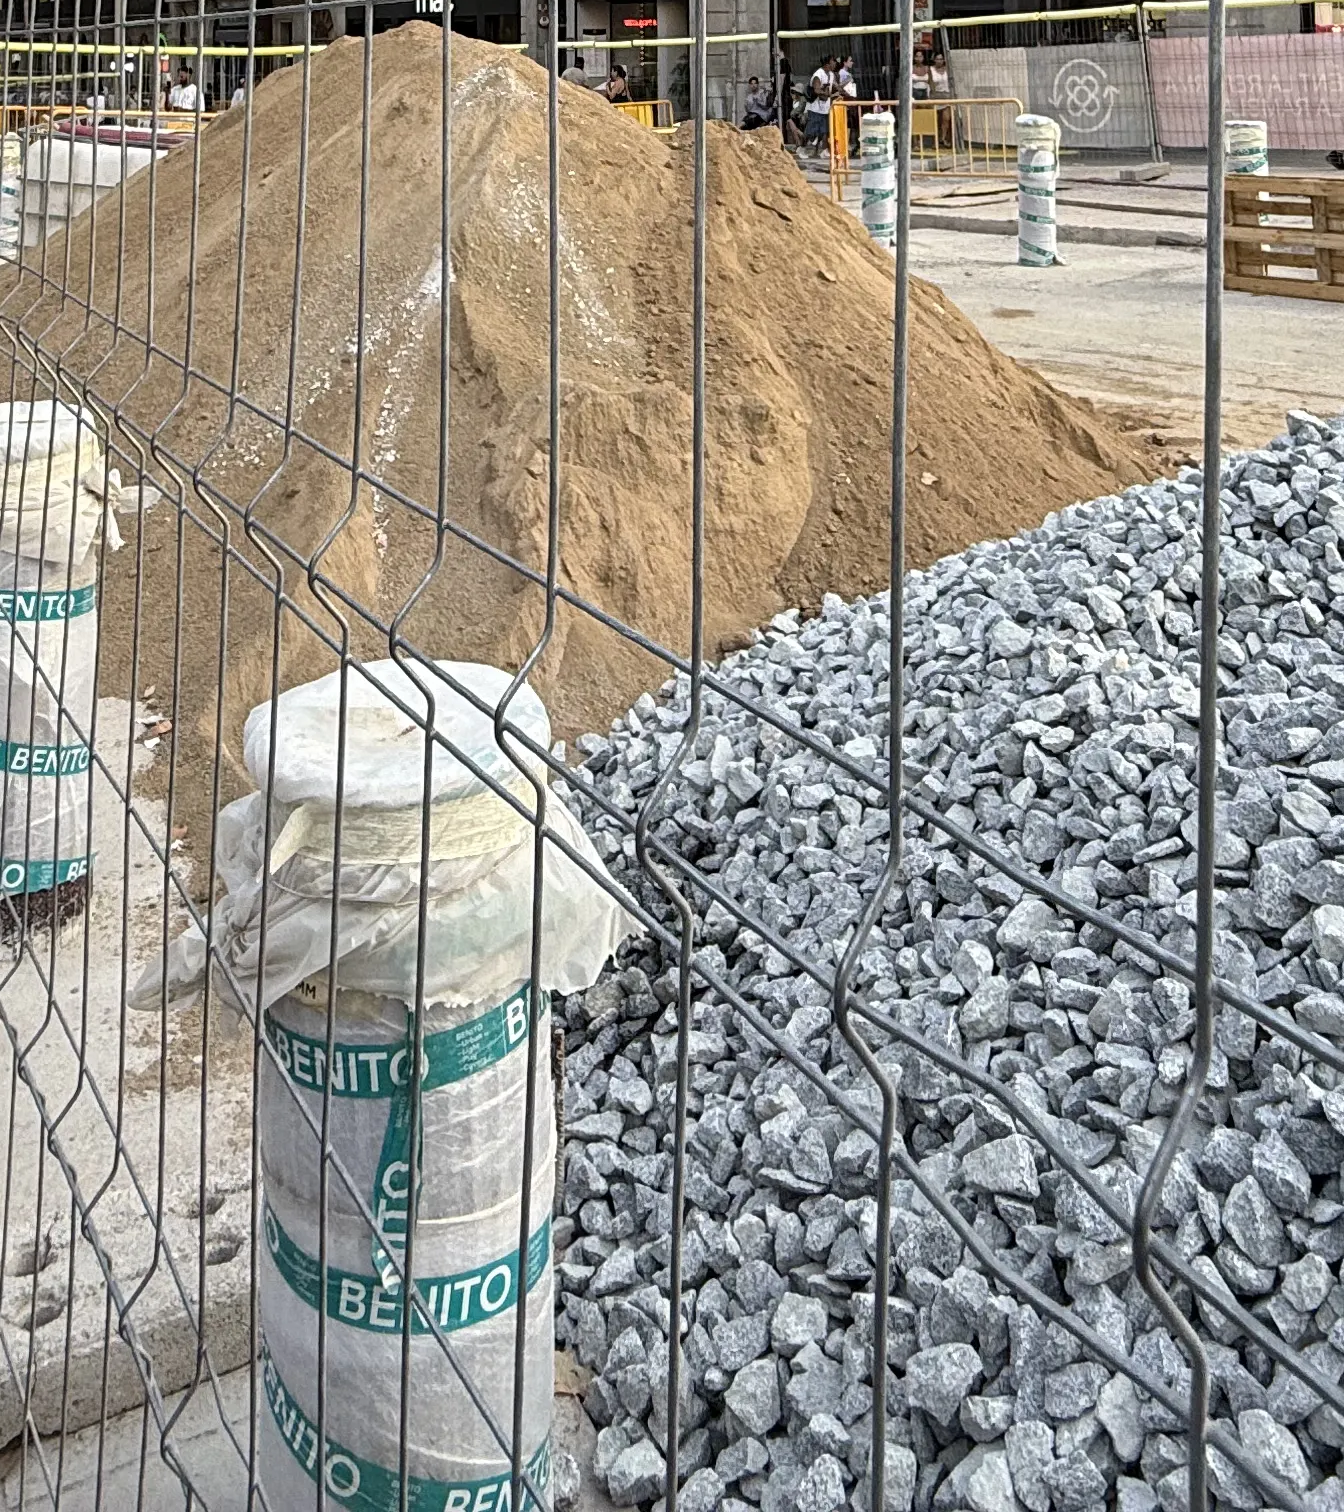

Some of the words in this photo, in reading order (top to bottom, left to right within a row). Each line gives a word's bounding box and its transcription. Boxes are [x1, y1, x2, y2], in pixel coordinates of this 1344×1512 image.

[11, 745, 90, 774] BENITO
[274, 1026, 430, 1093] BENITO
[338, 1263, 512, 1329] BENITO
